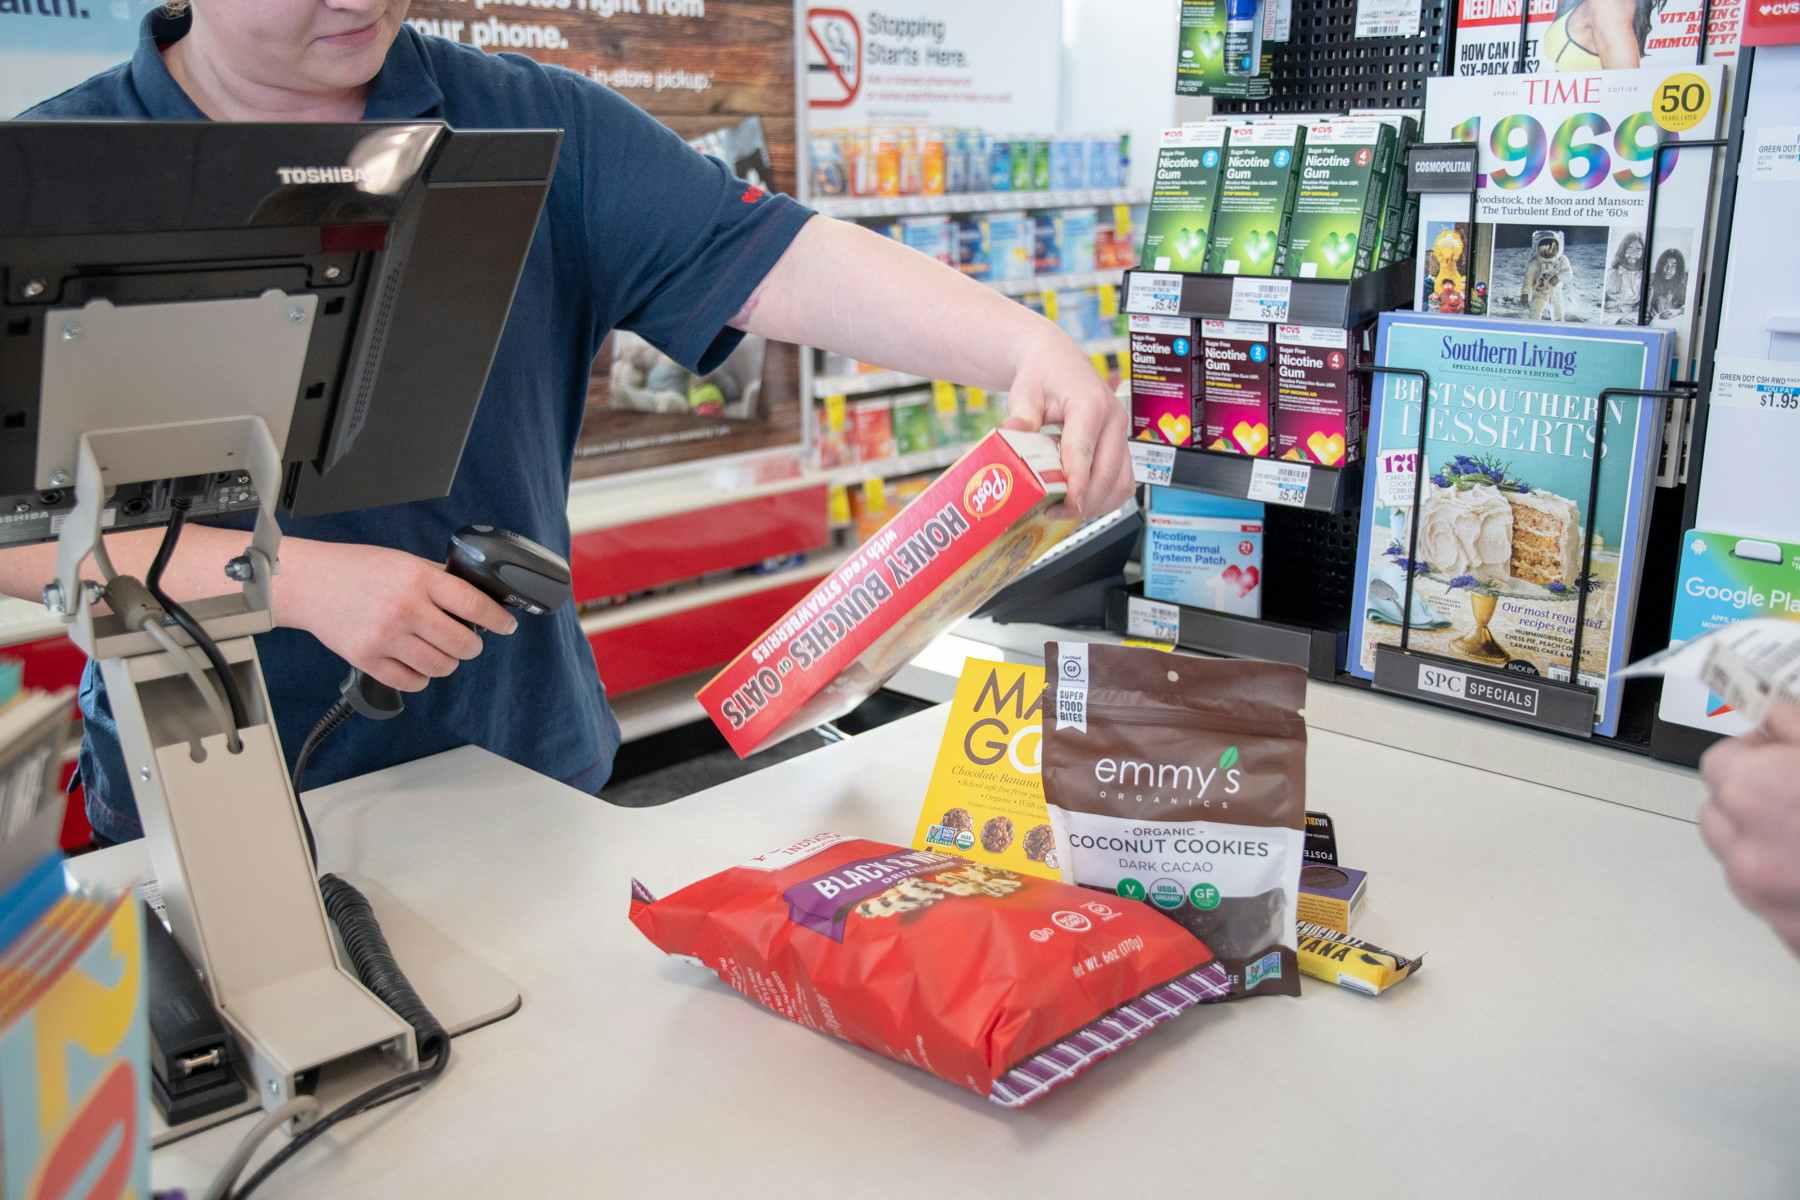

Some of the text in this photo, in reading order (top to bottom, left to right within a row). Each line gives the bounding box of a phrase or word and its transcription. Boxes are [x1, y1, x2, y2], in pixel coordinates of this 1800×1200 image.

[1773, 3, 1800, 15] CVS
[472, 15, 569, 49] phone.
[867, 12, 946, 43] Stopping
[1648, 33, 1737, 49] IMMUNTY?
[867, 43, 969, 67] Starts Here.
[1461, 42, 1485, 60] HOW
[1488, 40, 1509, 59] CAN
[1518, 40, 1539, 58] ET
[1512, 60, 1540, 74] AS?
[1523, 77, 1602, 105] TIME
[1660, 83, 1705, 113] 50
[1159, 157, 1200, 169] Nicotine
[1228, 156, 1271, 168] Nicotine
[1305, 154, 1351, 167] Nicotine
[1415, 160, 1472, 173] COSMOPOLITAN
[277, 166, 367, 185] TOSHIBA
[1157, 168, 1182, 180] Gum
[1226, 167, 1252, 180] Gum
[1303, 167, 1331, 179] Gum
[1477, 195, 1645, 207] oodstock, the Moon and Manson:
[1482, 206, 1499, 215] The
[1502, 206, 1549, 216] Turbulent
[1551, 207, 1571, 217] End
[1573, 207, 1584, 217] of
[1586, 208, 1604, 217] the
[1260, 306, 1286, 319] $5.49
[1132, 342, 1171, 355] Nicotine
[1205, 347, 1247, 361] Nicotine
[1132, 352, 1156, 365] Gum
[1279, 353, 1324, 369] Nicotine
[1441, 335, 1577, 377] Southern Living
[1206, 359, 1230, 371] Gum
[1452, 363, 1479, 371] SPECIAL
[1279, 366, 1305, 379] Gum
[1394, 378, 1627, 425] BEST SOUTHERN
[1760, 391, 1799, 409] $1.95
[1401, 403, 1608, 460] DESSERTS
[1385, 453, 1418, 473] 178
[972, 468, 1008, 513] Post
[1279, 489, 1304, 504] $5.49
[0, 511, 48, 524] SHIBA
[1152, 531, 1197, 542] Nicotine
[887, 501, 971, 590] HONEY
[1153, 541, 1221, 554] Transdermal
[1152, 552, 1227, 565] System Patch
[751, 528, 898, 665] with real STRAWBERRIES
[1685, 576, 1765, 609] Google
[1501, 602, 1550, 618] Our most
[789, 569, 894, 670] BUNCHES
[1519, 618, 1556, 631] recipes
[1504, 634, 1525, 643] CHESS
[1539, 640, 1561, 649] PEACH
[1515, 629, 1564, 643] HUMMINGBIRD
[1510, 642, 1540, 653] CARAMEL
[1541, 647, 1560, 656] CAKE
[1508, 663, 1526, 672] BACK
[1424, 670, 1462, 693] SPC
[721, 665, 783, 732] OATS
[1060, 690, 1084, 701] SUPER
[1470, 682, 1532, 707] SPECIALS
[1060, 700, 1083, 713] FOOD
[1060, 712, 1083, 723] BITES
[952, 766, 1041, 789] Chocolate Banana
[1100, 790, 1230, 810] ORGANICS
[1132, 827, 1196, 837] ORGANIC
[1069, 833, 1270, 857] COCONUT COOKIES
[1119, 858, 1214, 873] DARK CACAO
[813, 859, 894, 900] BLACK
[1156, 884, 1178, 893] USDA
[1193, 888, 1216, 899] GF
[1084, 934, 1144, 972] Wt. 6oz (170g)
